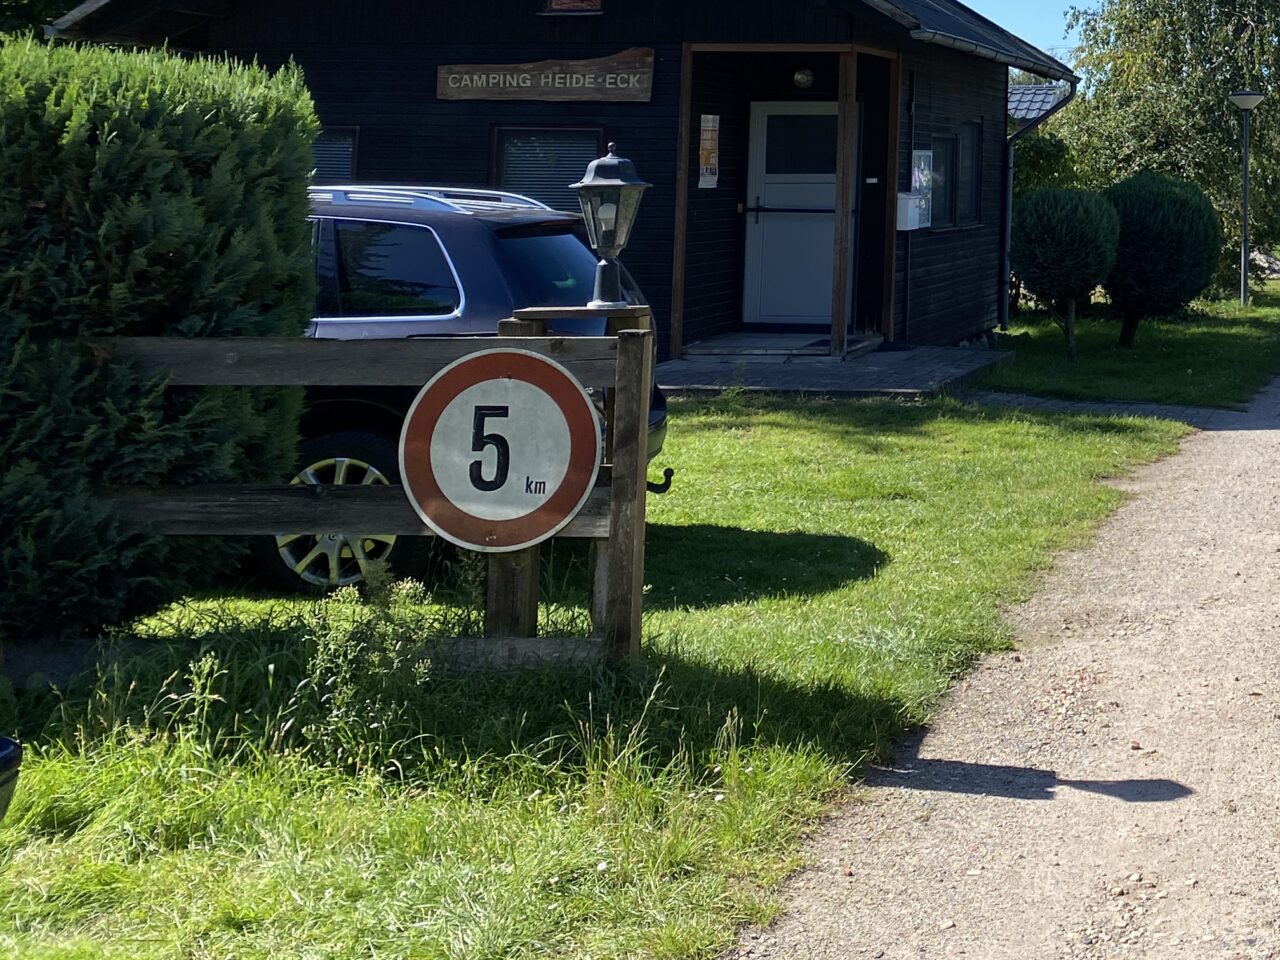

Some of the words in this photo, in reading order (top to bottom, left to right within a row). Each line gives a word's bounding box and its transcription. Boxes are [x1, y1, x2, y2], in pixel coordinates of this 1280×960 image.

[448, 73, 532, 89] CAMPING
[468, 405, 510, 492] 5
[525, 475, 546, 495] km
